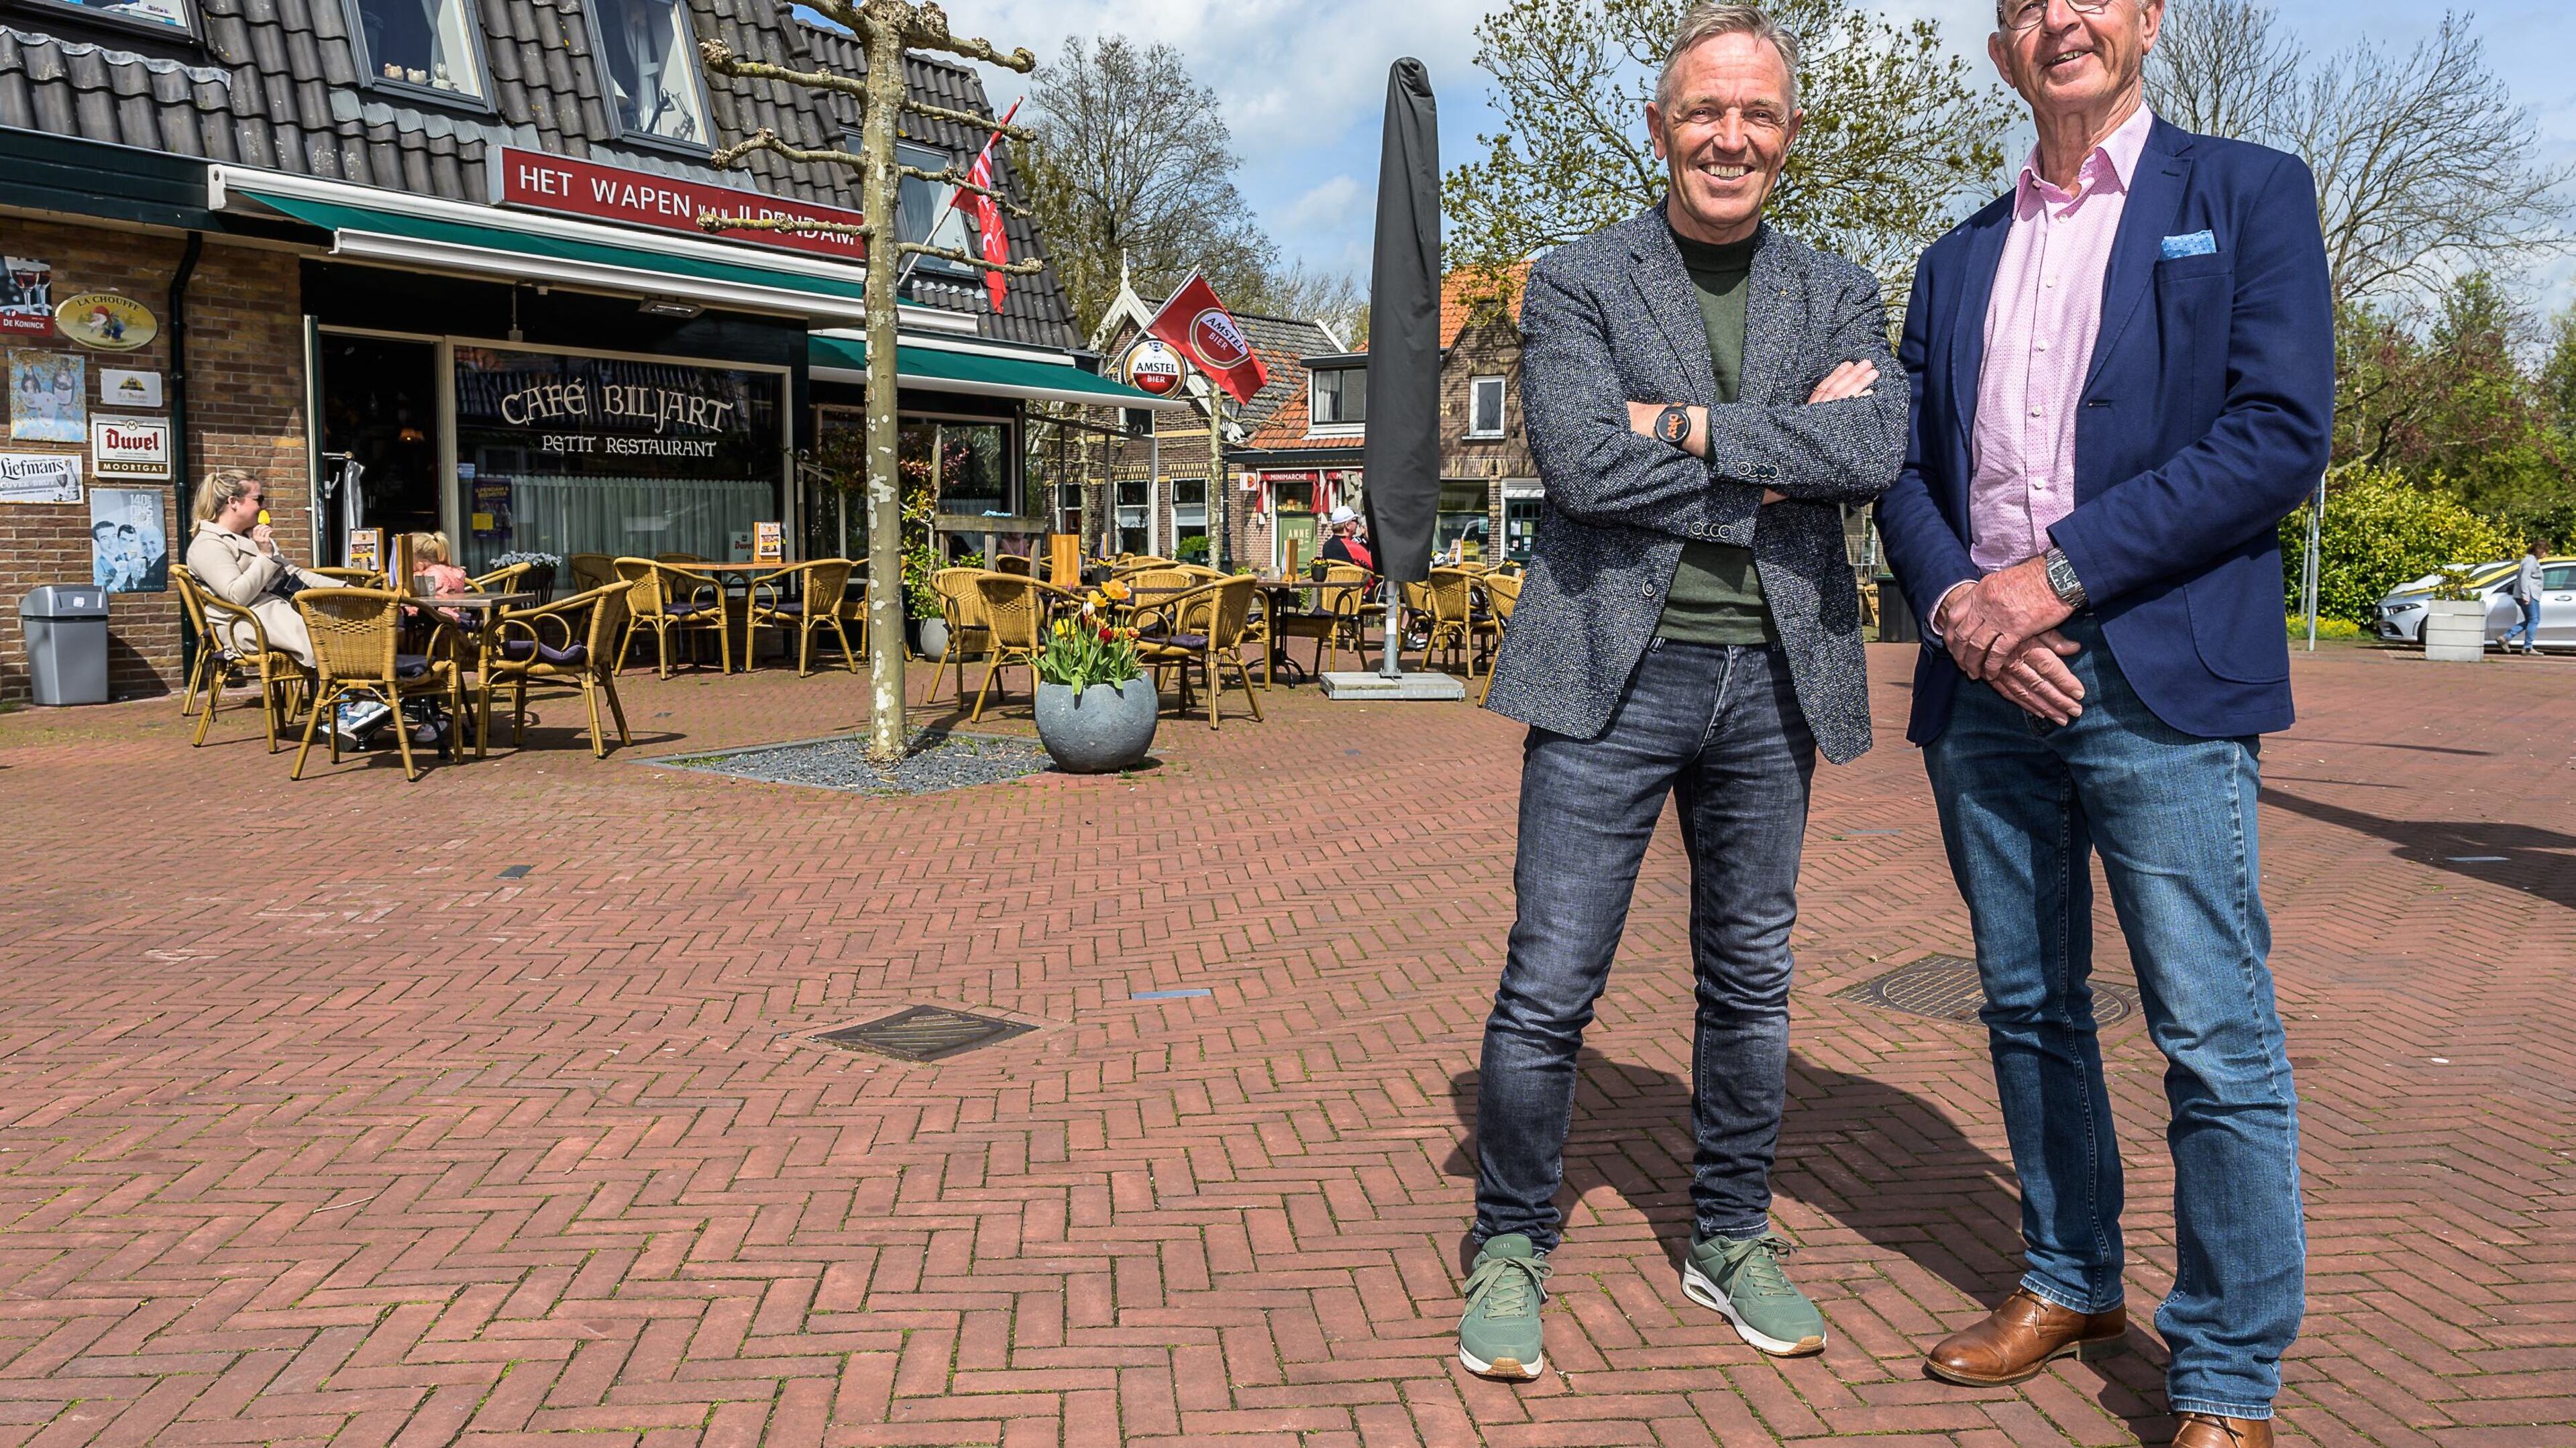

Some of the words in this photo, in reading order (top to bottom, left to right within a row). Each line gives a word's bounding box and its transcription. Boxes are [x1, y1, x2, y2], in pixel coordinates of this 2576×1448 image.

[519, 164, 573, 197] HET
[590, 177, 690, 218] WAPEN
[76, 297, 90, 307] LA
[93, 296, 140, 313] CHOUFFE
[3, 318, 13, 327] DE
[14, 319, 45, 329] KONINCK
[1206, 317, 1244, 351] AMSTEL
[1208, 332, 1228, 351] BIER
[1136, 362, 1177, 373] AMSTEL
[1147, 375, 1165, 383] BIER
[502, 377, 588, 427] CAFÉ
[603, 384, 733, 434] BILJART
[105, 428, 159, 451] Duvel
[542, 435, 597, 455] PETIT
[605, 437, 718, 457] RESTAURANT
[1, 457, 64, 480] Liefmans
[103, 463, 164, 472] MOORTGAT
[1271, 471, 1307, 480] MINIMARCHÉ
[1288, 528, 1309, 538] ANNE
[428, 581, 434, 592] 6
